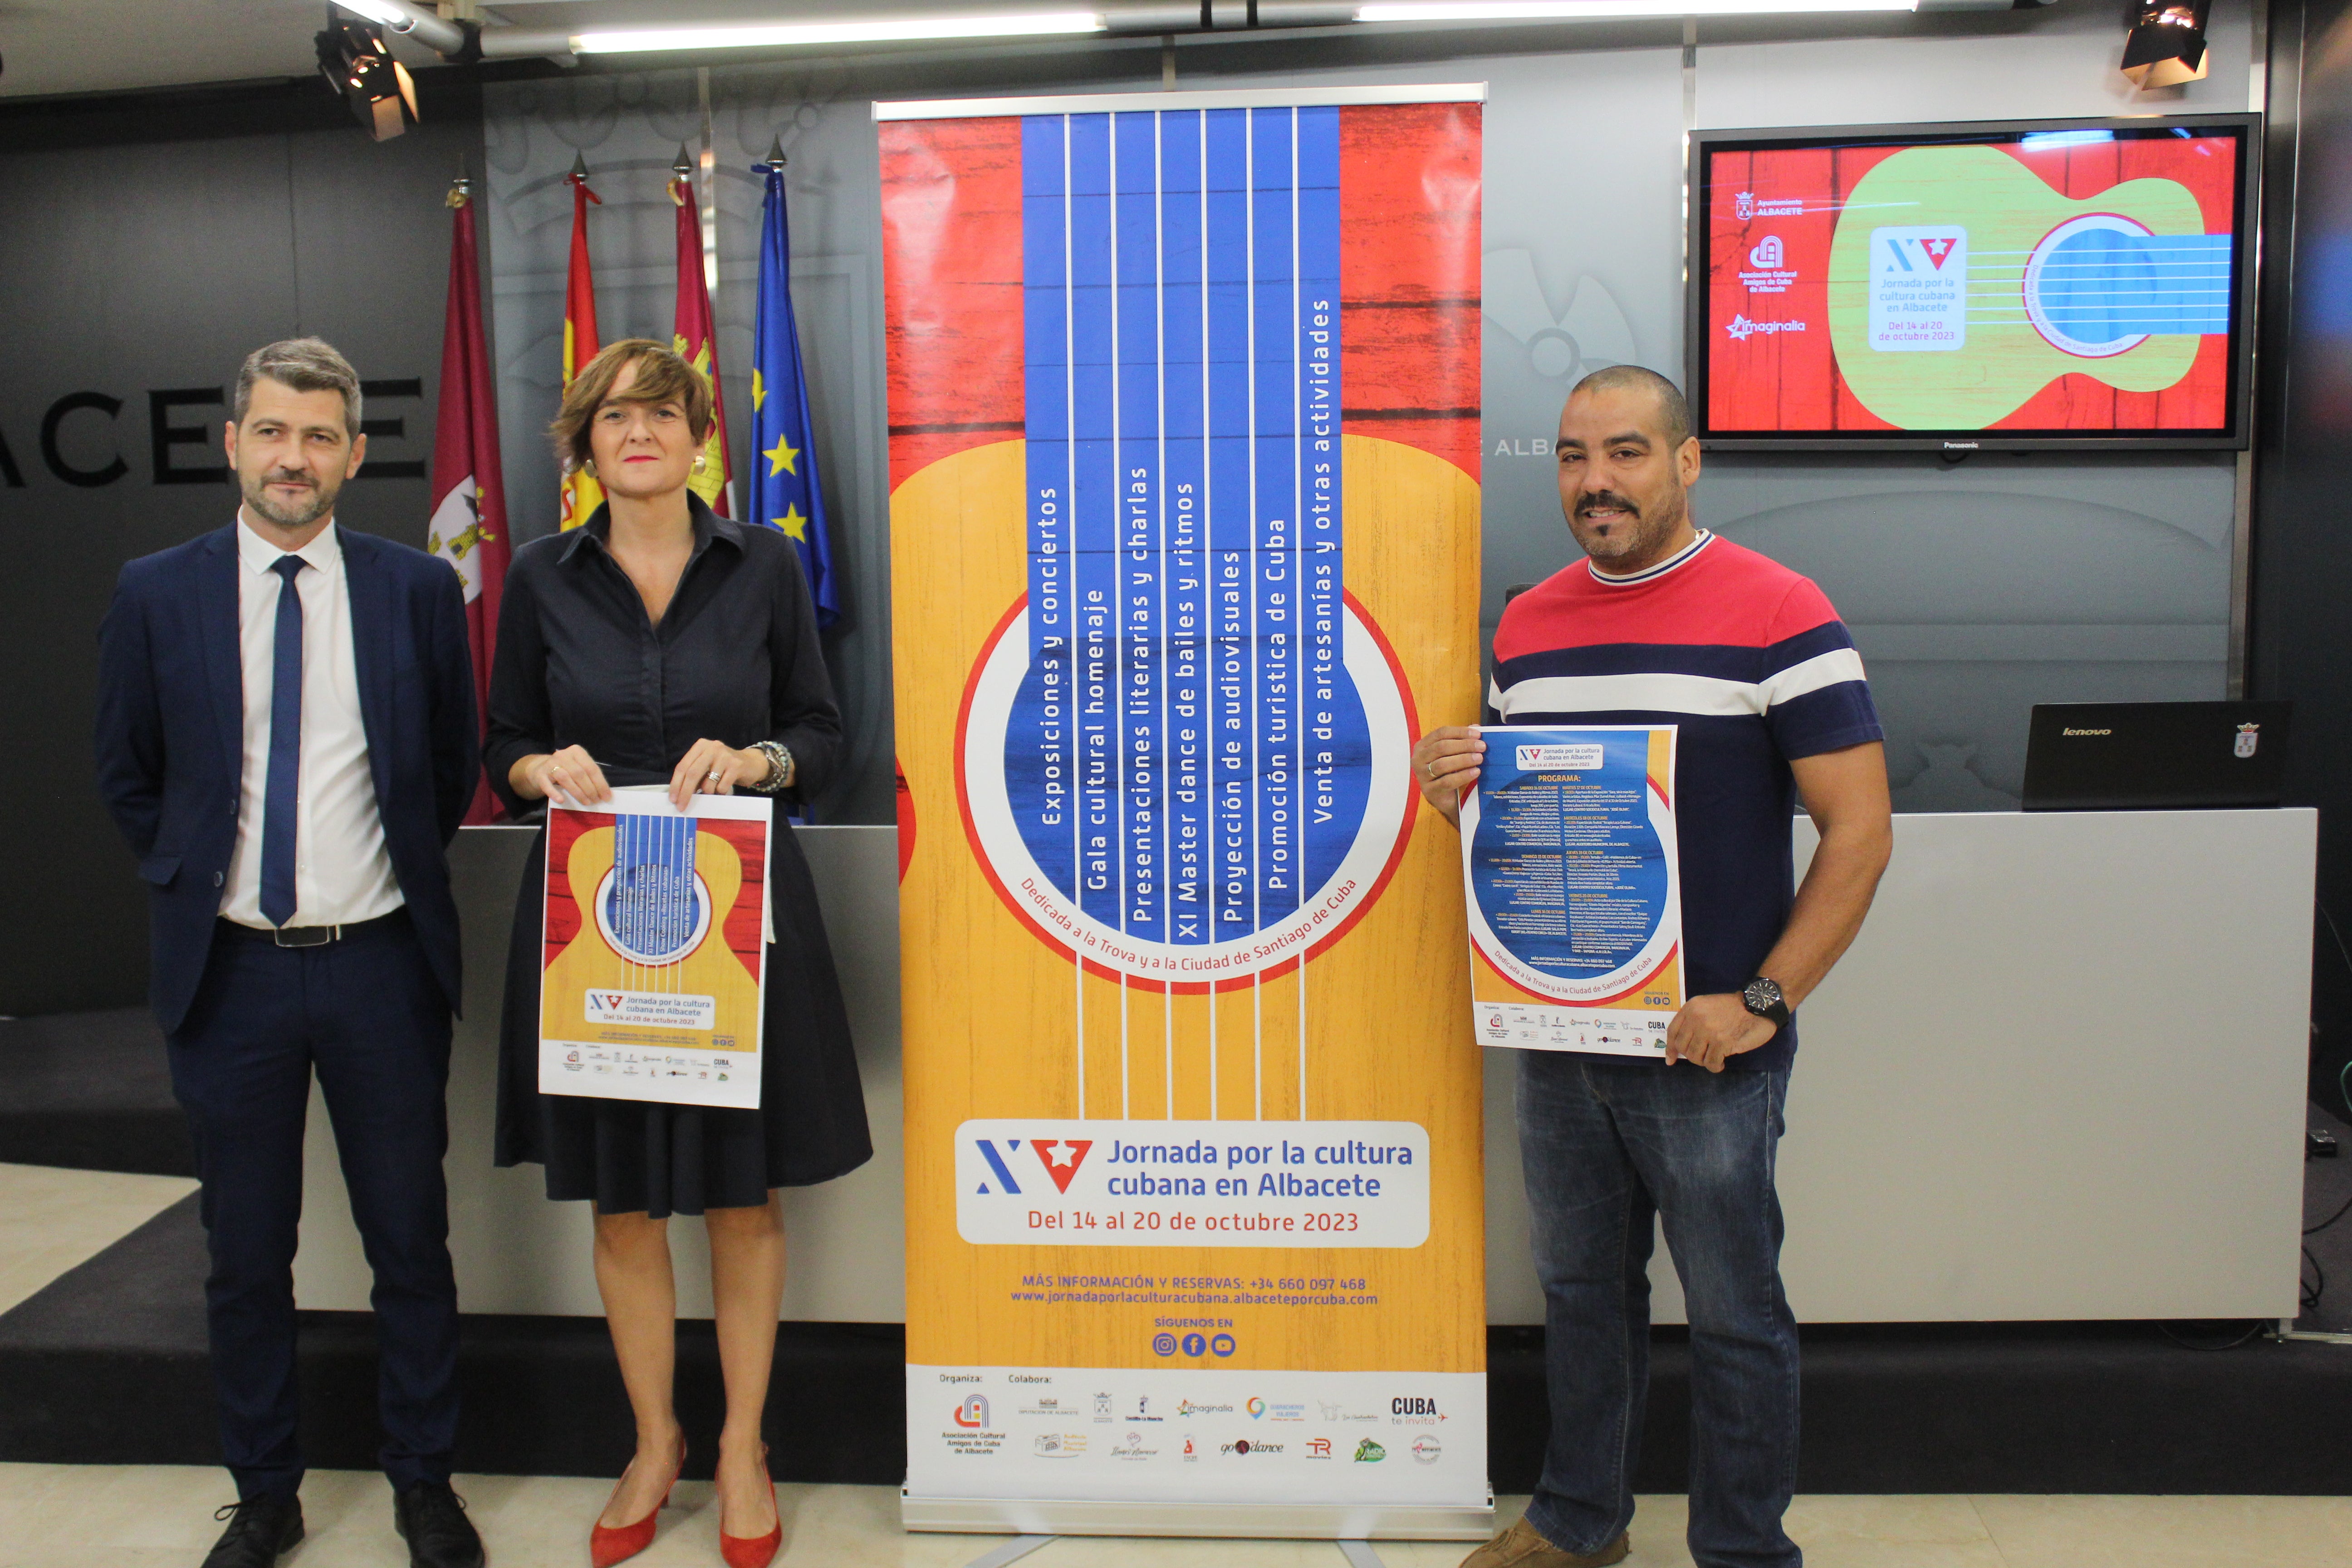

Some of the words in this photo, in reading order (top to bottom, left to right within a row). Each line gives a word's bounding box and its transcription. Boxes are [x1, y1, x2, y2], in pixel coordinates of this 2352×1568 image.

[1757, 207, 1803, 216] ALBACETE
[1880, 291, 1915, 300] cultura
[1918, 291, 1955, 300] cubana
[1881, 279, 1922, 288] Jornada
[1925, 280, 1942, 289] por
[1945, 278, 1954, 287] la
[1902, 303, 1947, 312] Albacete
[1742, 319, 1806, 335] imaginalia
[1888, 322, 1903, 330] Del
[1907, 322, 1916, 330] 14
[1931, 321, 1942, 329] 20
[1893, 332, 1929, 340] octubre
[1932, 332, 1954, 340] 2023
[1309, 300, 1329, 451] actividades
[1312, 463, 1330, 529] otras
[1127, 468, 1147, 560] charlas
[1173, 484, 1193, 565] ritmos
[1037, 489, 1057, 624] conciertos
[1265, 520, 1284, 580] Cuba
[1315, 542, 1336, 553] y
[1133, 573, 1152, 584] y
[1179, 577, 1198, 590] y
[1266, 593, 1285, 621] de
[1044, 637, 1062, 647] y
[1174, 602, 1194, 676] bailes
[1219, 553, 1240, 729] audiovisuales
[1310, 565, 1331, 700] artesanías
[1083, 591, 1107, 713] homenaje
[1129, 597, 1149, 714] literarias
[1176, 689, 1195, 716] de
[1313, 712, 1332, 740] de
[2063, 727, 2112, 736] lenovo
[1040, 660, 1065, 824] Exposiciones
[1221, 742, 1241, 769] de
[1085, 726, 1106, 824] cultural
[1176, 729, 1196, 802] dance
[1313, 752, 1333, 823] Venta
[1130, 727, 1152, 921] Presentaciones
[1266, 754, 1287, 889] Promoción
[1087, 837, 1106, 890] Gala
[1177, 814, 1198, 902] Master
[1221, 781, 1246, 922] Proyección
[1021, 878, 1071, 930] Dedicada
[1073, 927, 1081, 937] a
[1083, 931, 1096, 946] la
[1100, 939, 1136, 962] Trova
[1140, 956, 1148, 968] y
[1152, 958, 1159, 968] a
[1165, 957, 1176, 970] la
[1182, 955, 1230, 970] Ciudad
[1234, 952, 1251, 965] de
[1254, 923, 1311, 959] Santiago
[1313, 908, 1328, 924] de
[1327, 880, 1356, 909] Cuba
[1178, 914, 1197, 937] XI
[1494, 951, 1519, 975] Dedicada
[1533, 978, 1549, 989] Trova
[1602, 975, 1630, 990] Santiago
[1637, 957, 1651, 971] Cuba
[626, 996, 657, 1005] Jornada
[626, 1005, 653, 1014] cubana
[667, 1007, 701, 1016] Albacete
[1107, 1140, 1216, 1164] Jornada
[1228, 1146, 1273, 1170] por
[1283, 1141, 1304, 1164] la
[1315, 1140, 1411, 1165] cultura
[1108, 1172, 1205, 1196] cubana
[1216, 1179, 1247, 1196] en
[1258, 1173, 1380, 1196] Albacete
[1029, 1211, 1063, 1229] Del
[1073, 1211, 1097, 1229] 14
[1107, 1211, 1124, 1229] al
[1134, 1212, 1160, 1230] 20
[1170, 1212, 1196, 1230] de
[1205, 1213, 1294, 1231] octubre
[1304, 1213, 1357, 1231] 2023
[1023, 1274, 1053, 1287] MÁS
[1058, 1274, 1154, 1289] INFORMACIÓN
[1160, 1277, 1167, 1288] Y
[1173, 1277, 1244, 1289] RESERVAS:
[1250, 1278, 1274, 1289] +34
[1279, 1278, 1305, 1290] 660
[1310, 1278, 1335, 1290] 097
[1340, 1279, 1366, 1290] 468
[1011, 1290, 1378, 1307] www.jornadaporlaculturacubana.albaceteporcuba.com
[1155, 1317, 1215, 1328] SÍGUENOS
[1218, 1318, 1233, 1328] EN
[940, 1374, 982, 1384] Organiza:
[1009, 1374, 1051, 1383] Colabora:
[1187, 1404, 1233, 1414] imaginalia
[1392, 1397, 1436, 1415] CUBA
[1405, 1416, 1435, 1425] invita
[1221, 1445, 1235, 1455] go
[1250, 1440, 1284, 1452] dance
